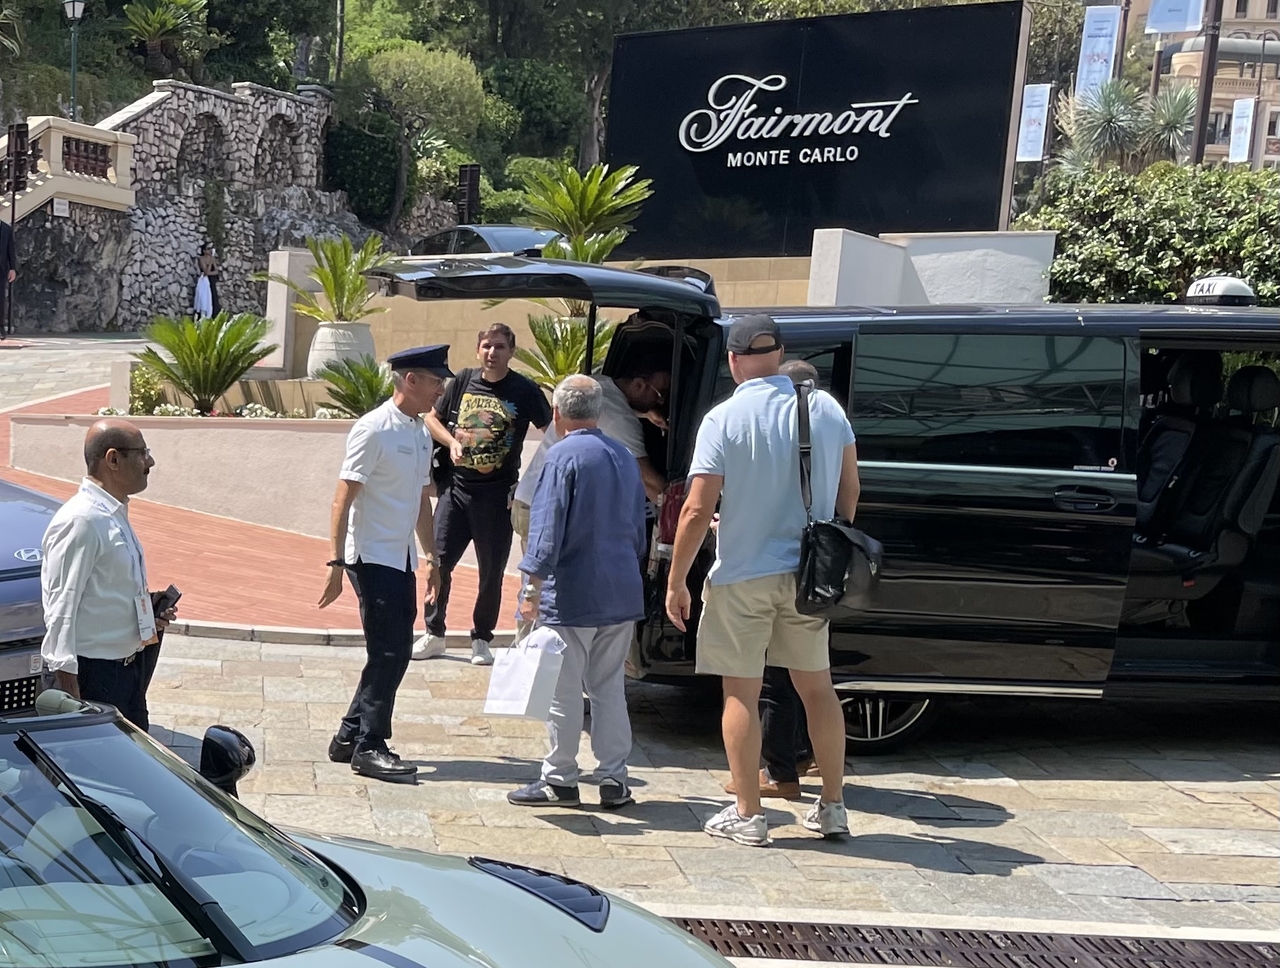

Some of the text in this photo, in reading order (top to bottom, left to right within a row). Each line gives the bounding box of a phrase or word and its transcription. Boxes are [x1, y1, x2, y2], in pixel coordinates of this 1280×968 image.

[678, 74, 919, 152] Fairmont
[726, 145, 859, 168] MONTE CARLO
[1194, 281, 1217, 294] TAXI
